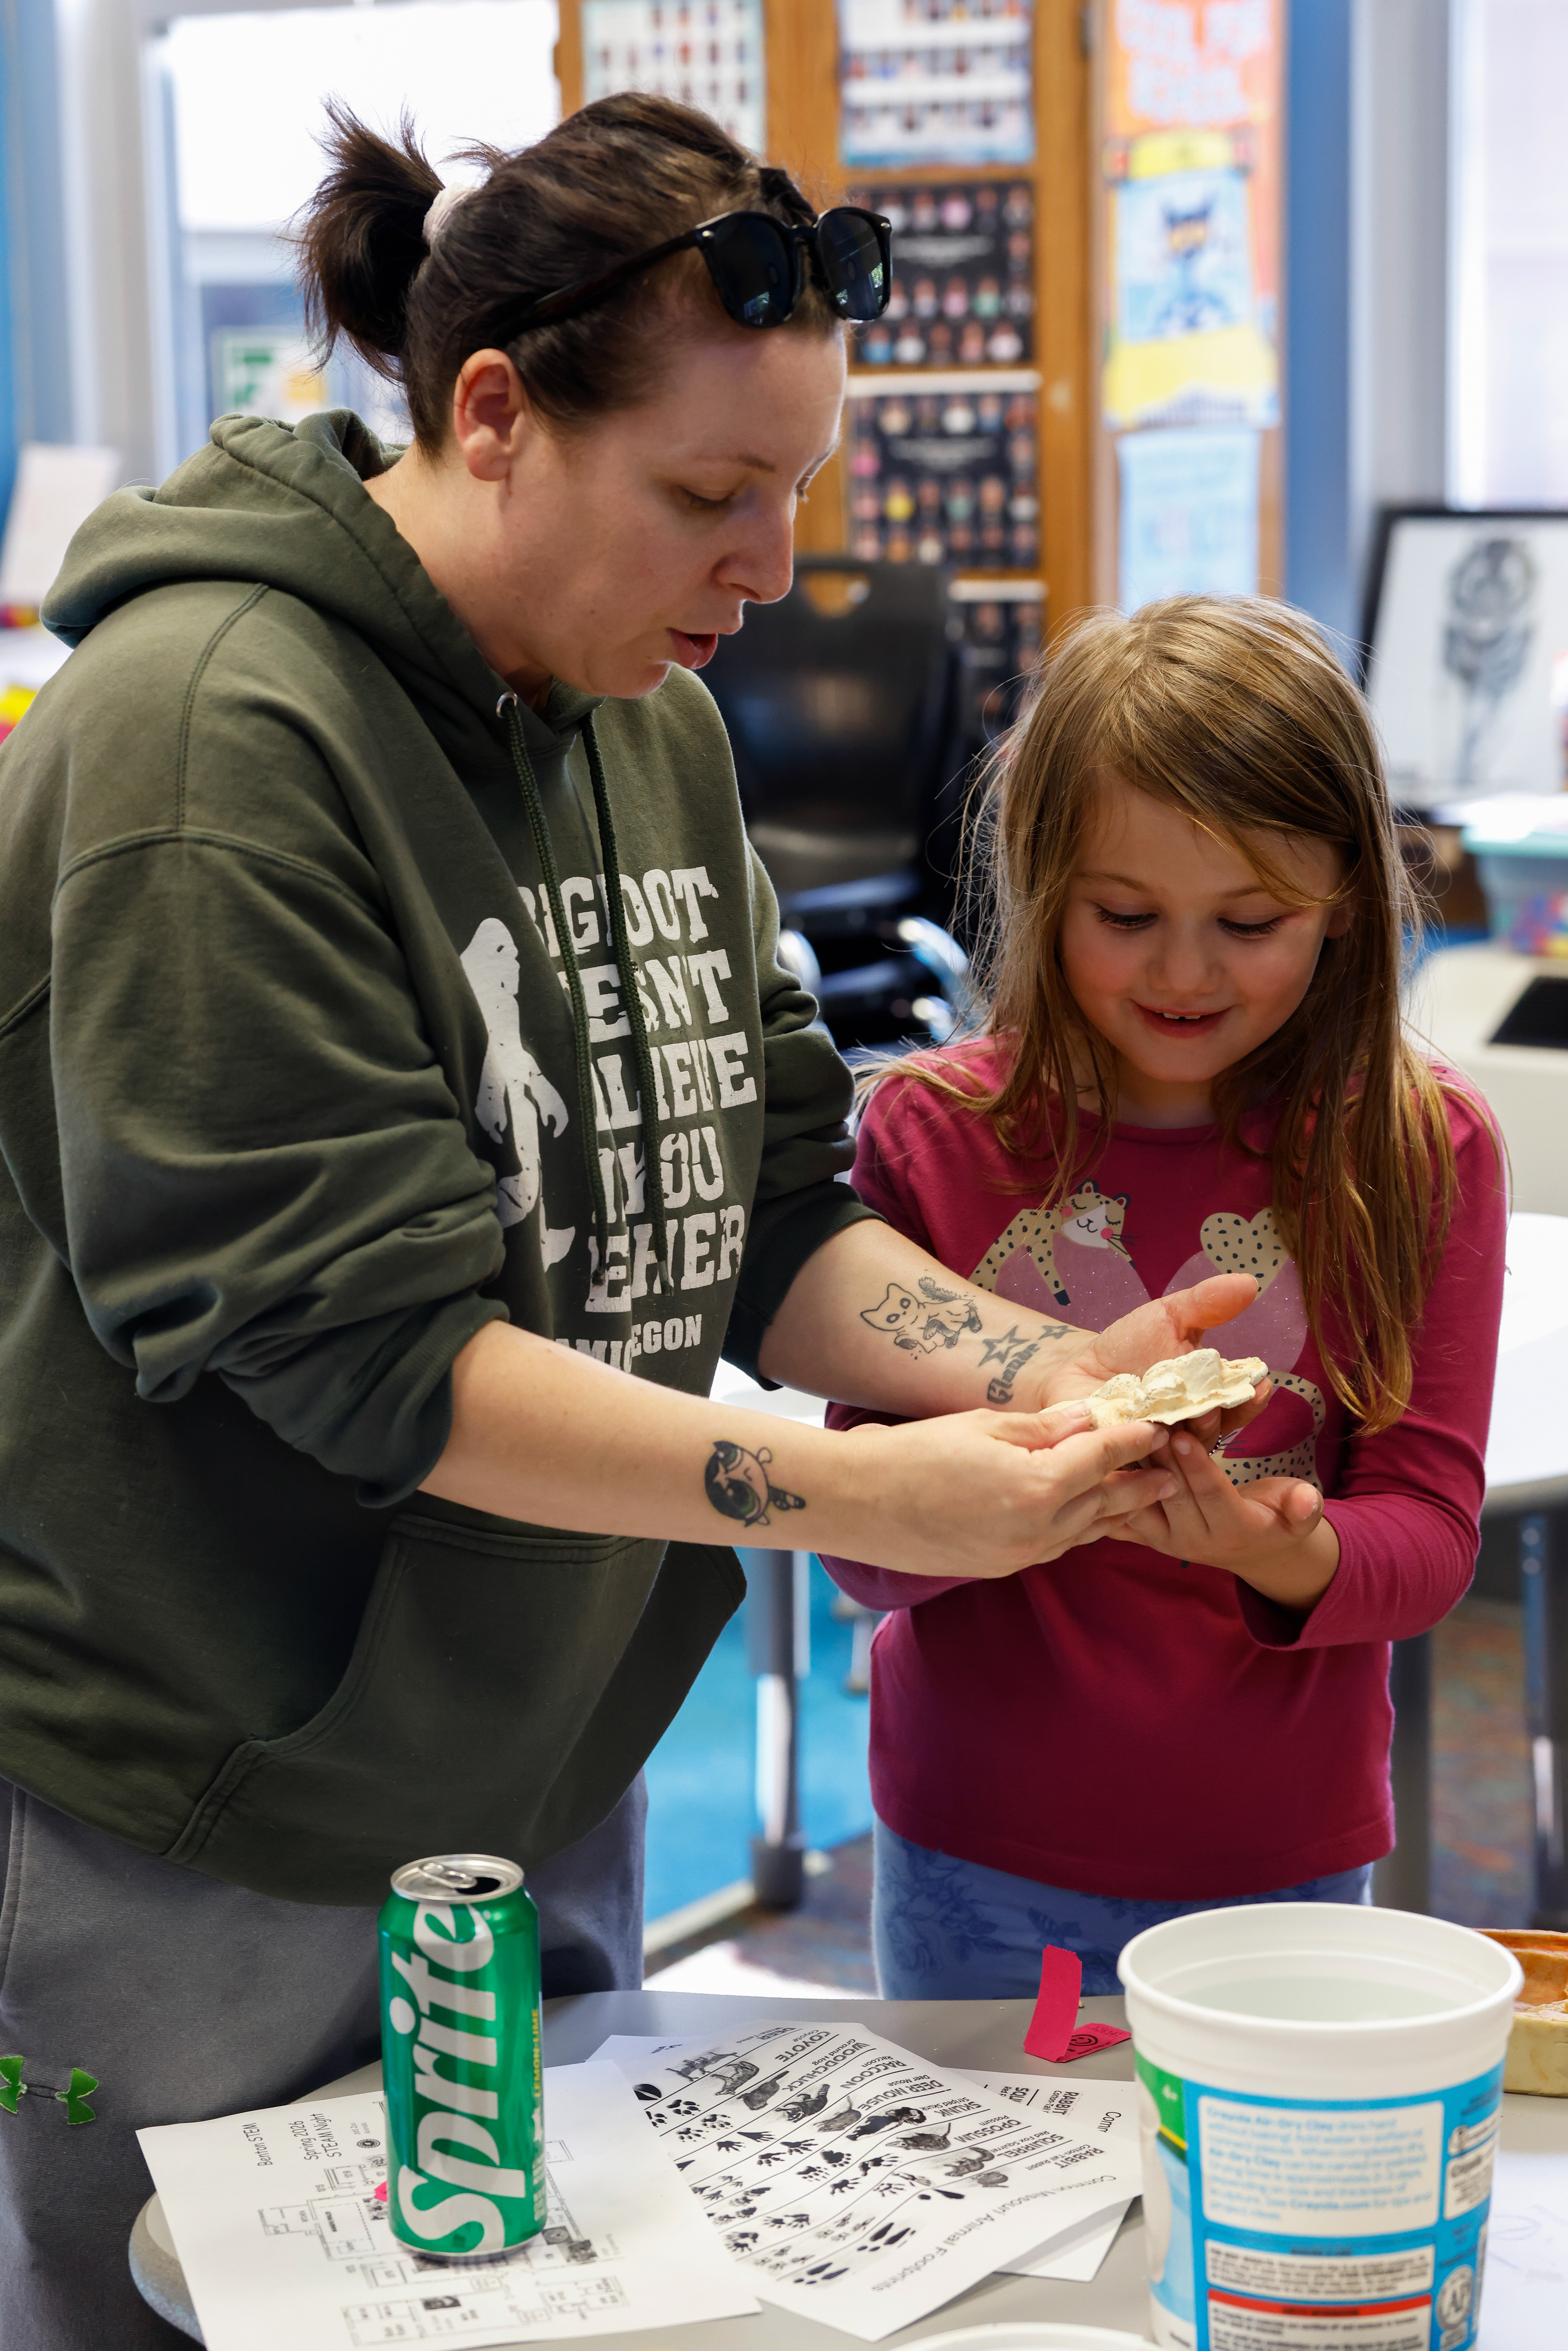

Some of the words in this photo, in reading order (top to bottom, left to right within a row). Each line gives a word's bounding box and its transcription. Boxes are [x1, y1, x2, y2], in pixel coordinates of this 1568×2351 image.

[757, 2028, 796, 2040] DEER
[792, 2030, 819, 2042] Coyote
[532, 2008, 541, 2098] LEMON-LIME
[775, 2031, 831, 2062] COYOTE
[829, 2039, 856, 2057] Ground
[782, 2042, 870, 2091] WOODCHUCK
[811, 2056, 829, 2066] Hog
[861, 2055, 893, 2067] Raccoon
[390, 1901, 526, 2255] Sprite
[840, 2060, 908, 2089] RACCOON
[887, 2078, 912, 2086] Mouse
[906, 2080, 944, 2093] DEER
[858, 2088, 909, 2111] MOUSE
[919, 2103, 943, 2111] Skunk
[943, 2097, 970, 2107] Striped
[1042, 2090, 1062, 2113] Cotton-Tail
[1052, 2091, 1080, 2115] RABBIT
[934, 2101, 982, 2117] SKUNK
[288, 2120, 309, 2137] 2026
[310, 2113, 332, 2131] Night
[361, 2122, 371, 2134] Animals
[979, 2115, 1009, 2126] Possum
[242, 2122, 263, 2142] STEM
[954, 2119, 1022, 2144] OPOSSUM
[1036, 2130, 1050, 2139] Red
[299, 2137, 322, 2160] Spring
[316, 2130, 342, 2157] STEAM
[990, 2141, 1020, 2154] Squirrel
[996, 2134, 1065, 2158] SQUIRREL
[254, 2142, 273, 2166] Benton
[1049, 2144, 1091, 2162] Cotton-Tail
[1054, 2148, 1105, 2169] RABBIT
[1025, 2159, 1051, 2171] Rabbit
[1055, 2175, 1116, 2192] Common
[992, 2188, 1057, 2215] Missouri
[943, 2213, 995, 2246] Animal
[872, 2246, 948, 2292] Footprints
